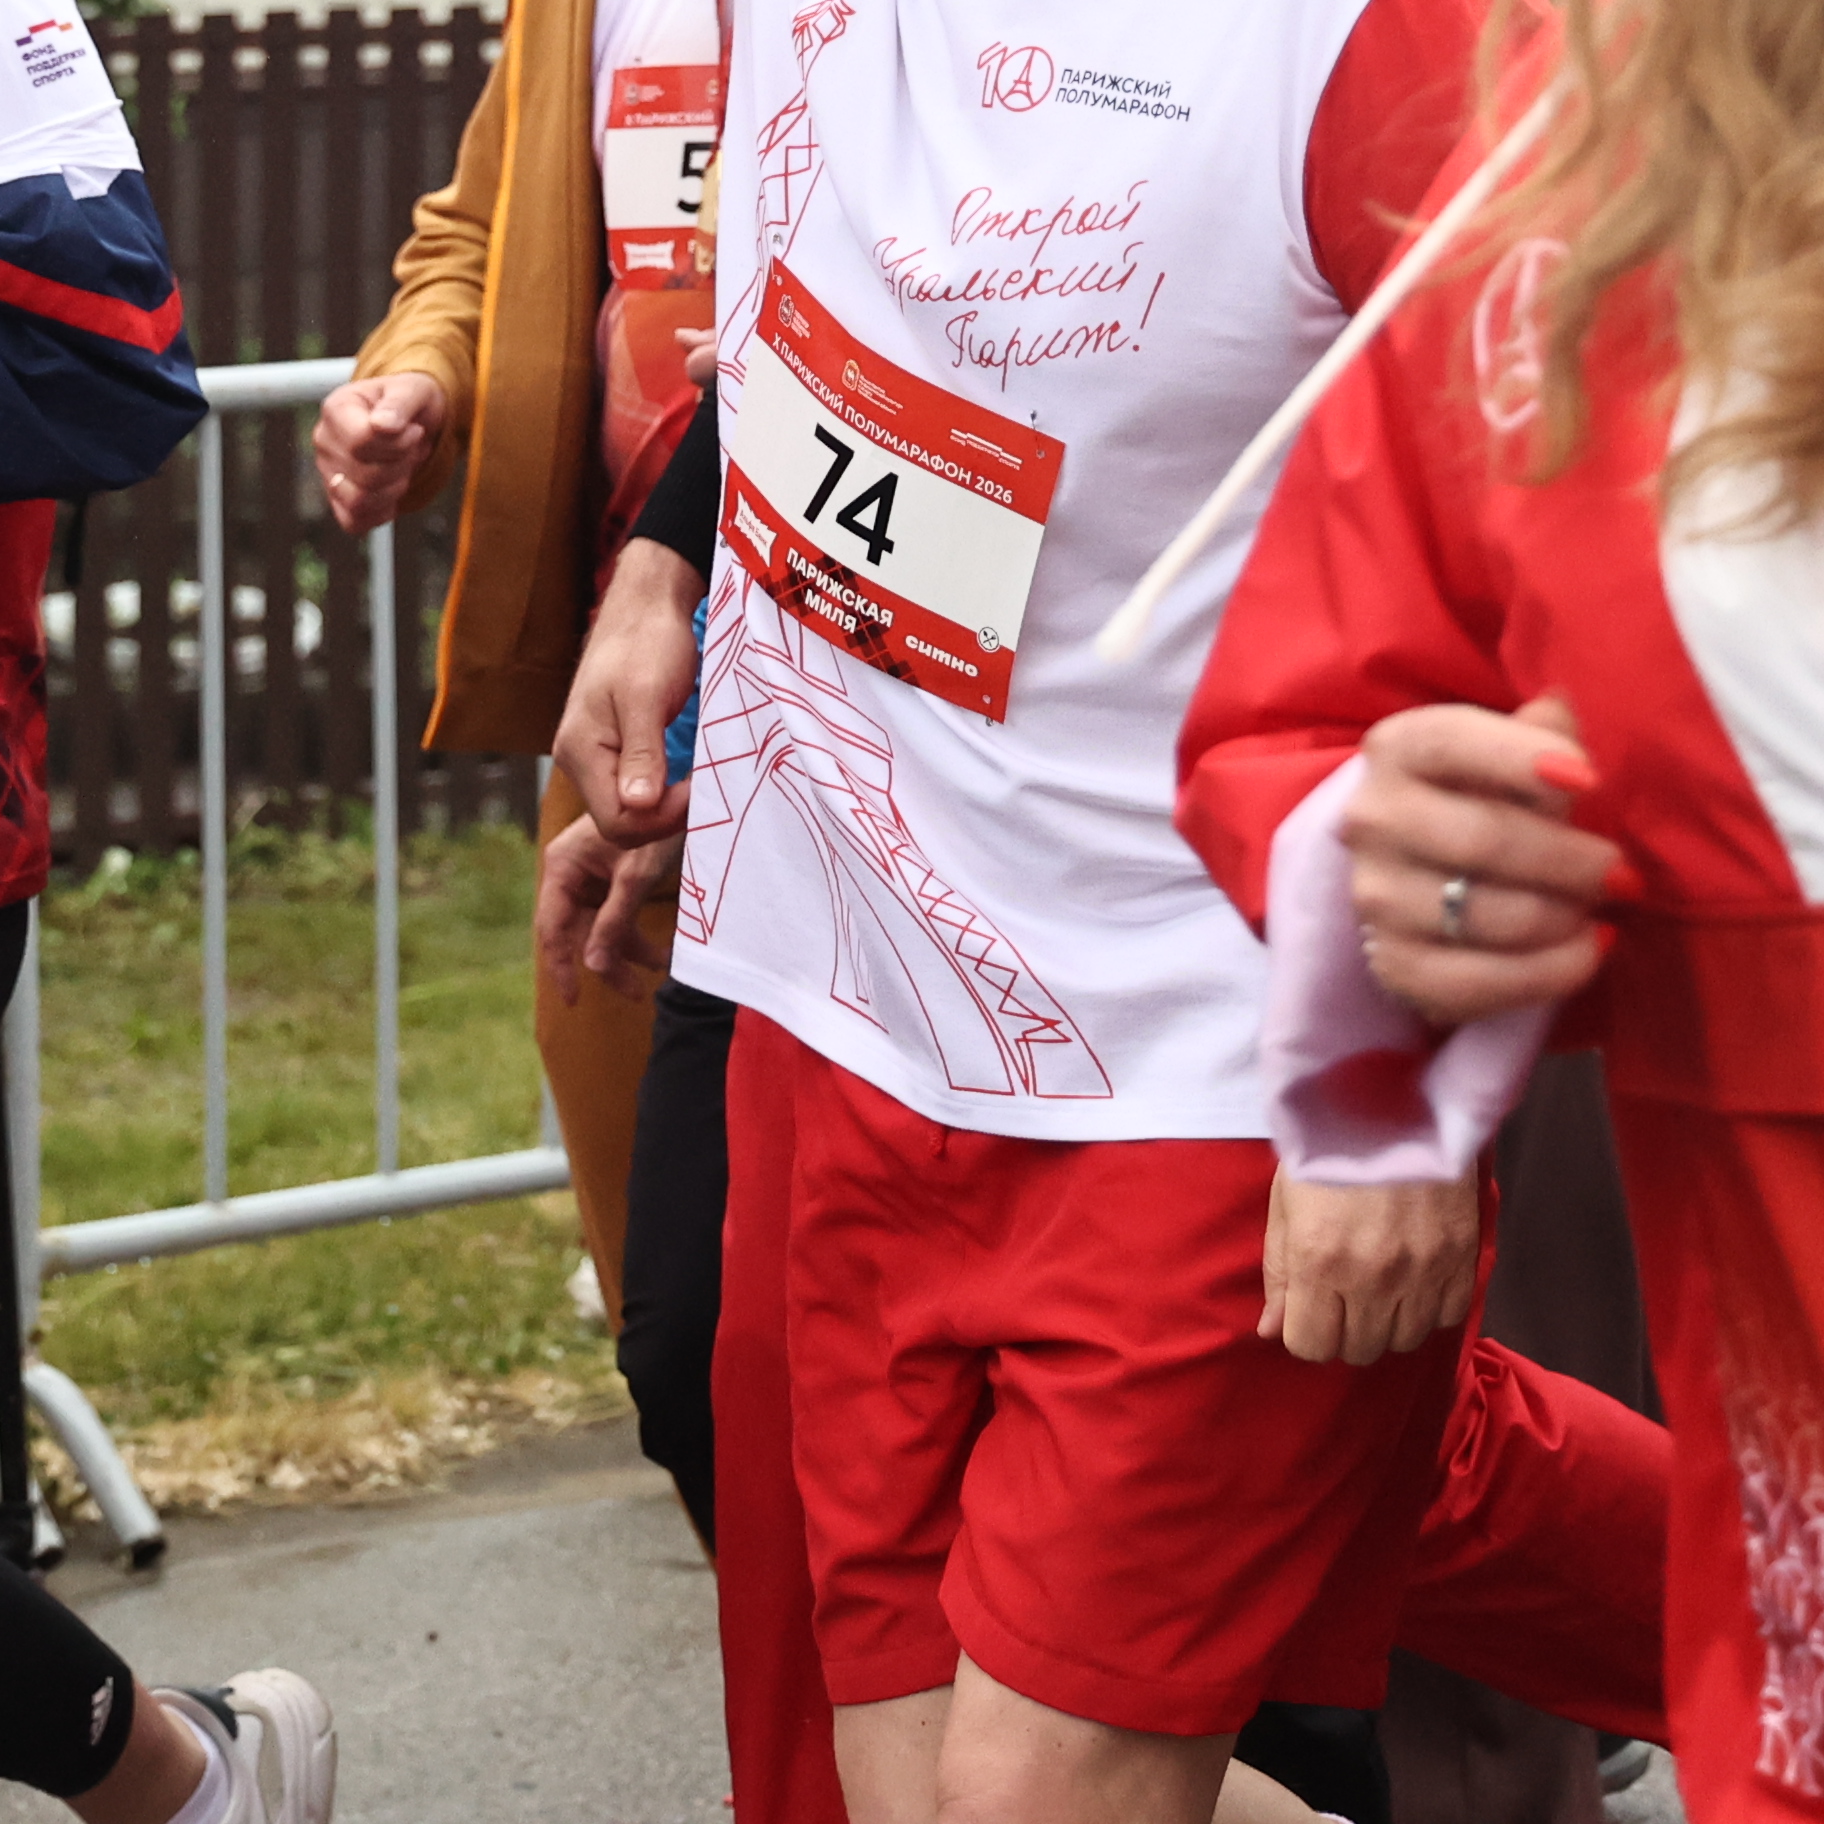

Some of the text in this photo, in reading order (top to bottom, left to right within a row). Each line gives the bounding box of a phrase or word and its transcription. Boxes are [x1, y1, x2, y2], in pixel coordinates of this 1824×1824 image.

[1055, 87, 1191, 122] ПОЛУМАРАФОН
[1061, 68, 1172, 100] ПАРИЖСКИЙ
[951, 179, 1149, 267] Открой
[873, 236, 1144, 316] Уральский
[945, 271, 1166, 393] Париж!
[780, 342, 844, 414] ПАРИЖСКИЙ
[844, 404, 972, 485] ПОЛУМАРАФОН
[975, 475, 1013, 504] 2026
[803, 422, 899, 566] 74
[786, 546, 894, 628] ПАРИЖСКАЯ
[805, 588, 858, 634] МИЛЯ
